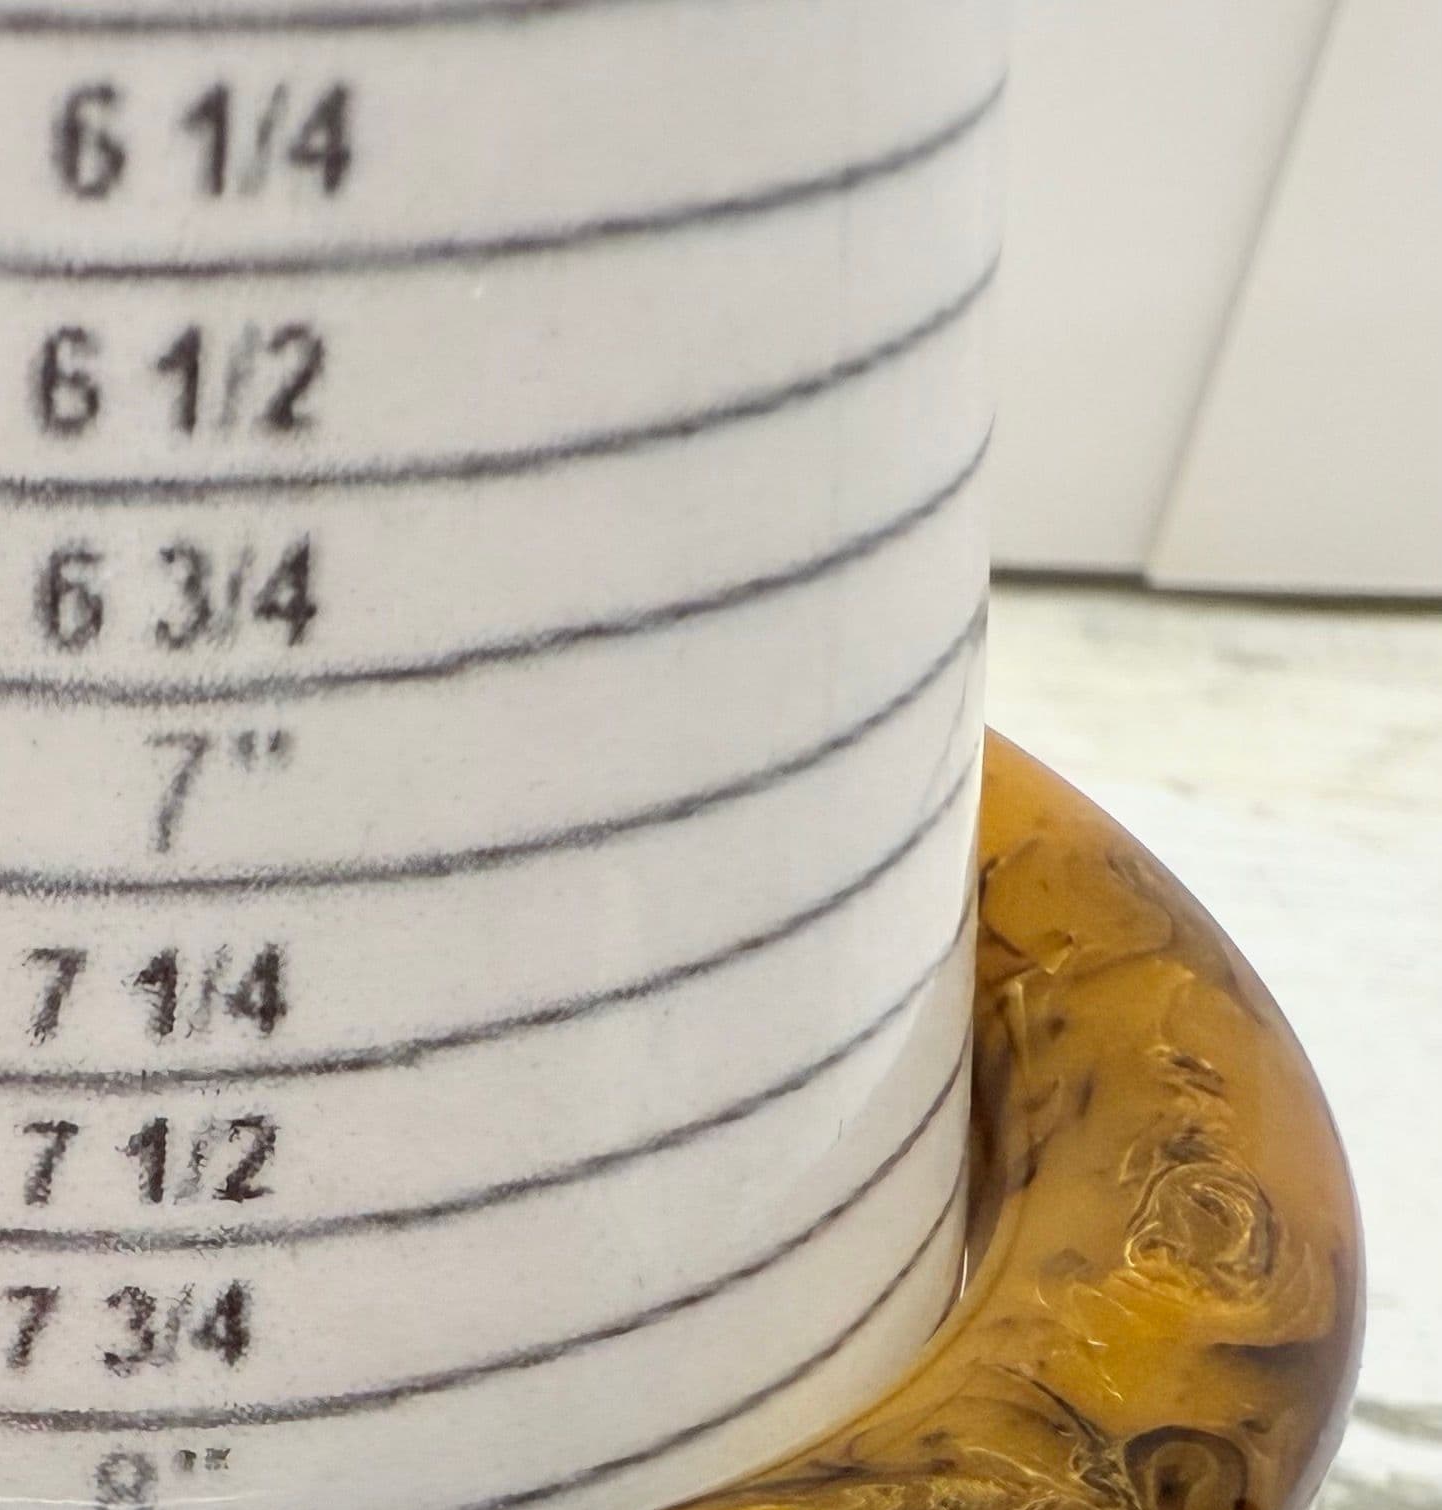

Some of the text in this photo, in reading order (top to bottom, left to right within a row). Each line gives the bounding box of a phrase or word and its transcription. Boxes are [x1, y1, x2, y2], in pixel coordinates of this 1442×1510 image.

[52, 80, 353, 199] 6 1/4
[35, 321, 325, 437] 6 1/2
[37, 530, 318, 651] 6 3/4
[22, 943, 288, 1046] 7 1/4
[17, 1113, 279, 1206] 7 1/2
[1, 1278, 253, 1376] 7 3/4
